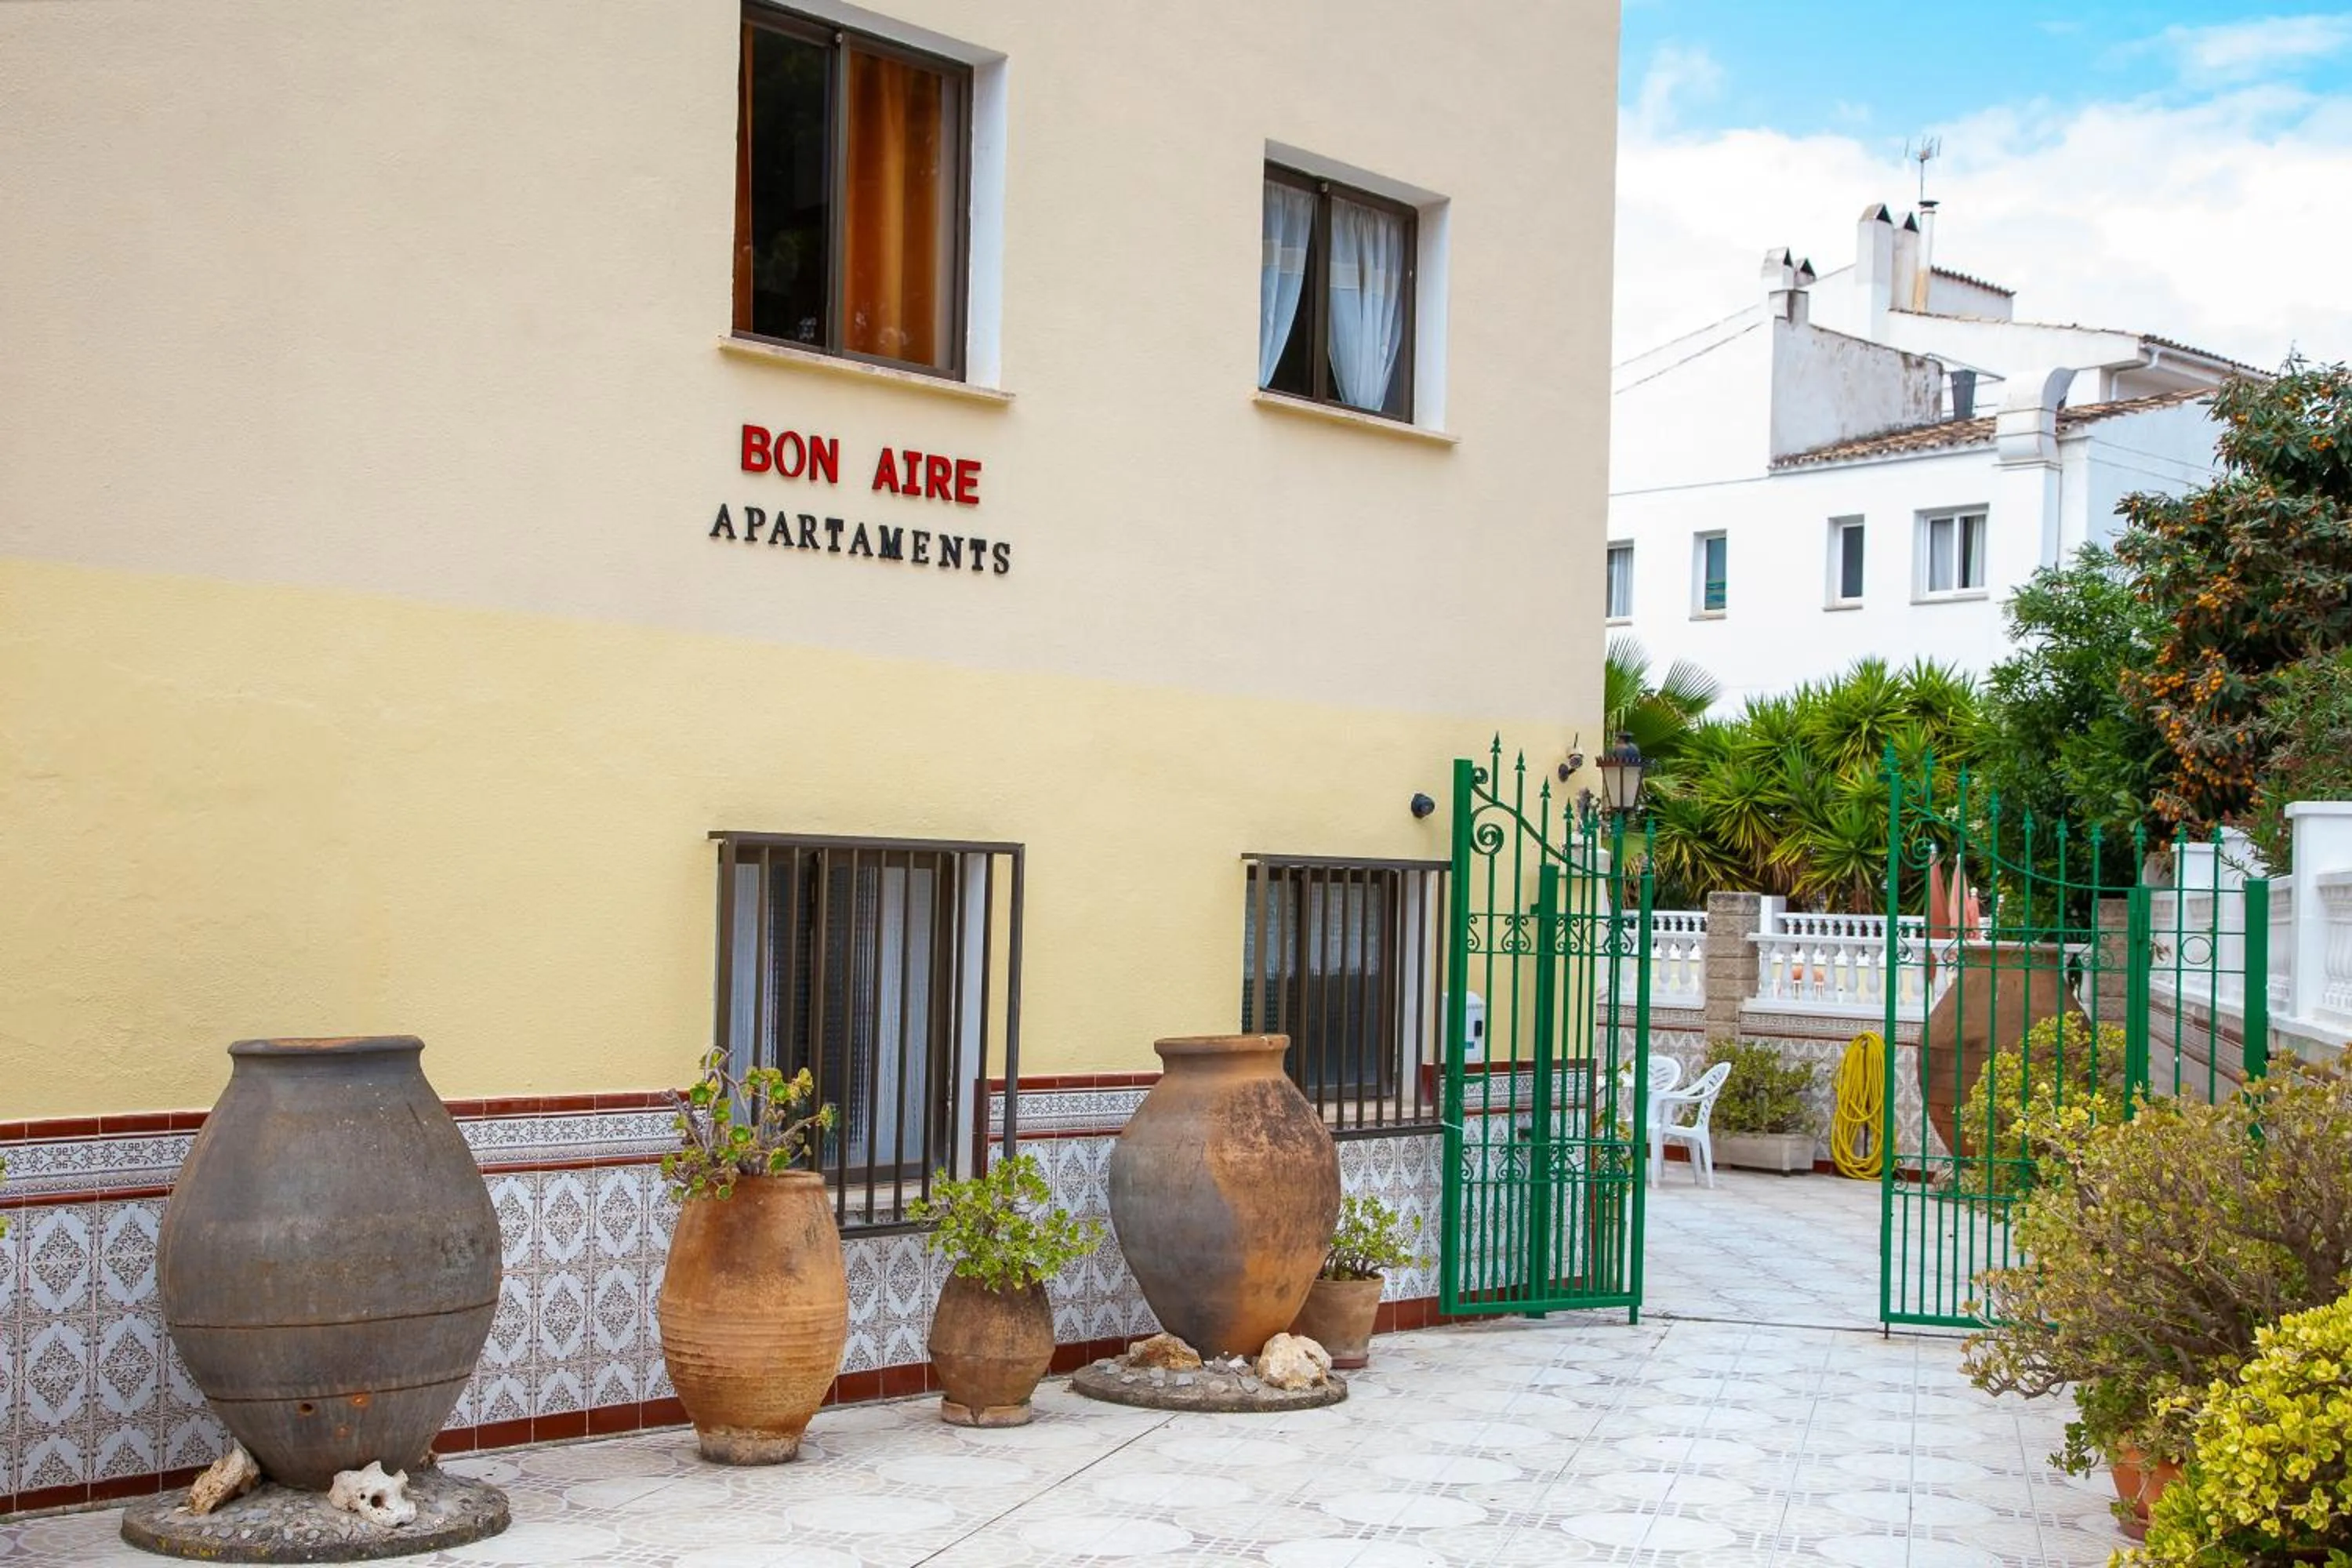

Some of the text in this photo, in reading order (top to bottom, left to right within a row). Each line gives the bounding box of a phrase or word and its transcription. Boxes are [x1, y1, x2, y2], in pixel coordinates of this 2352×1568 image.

[742, 424, 982, 505] BON AIRE
[709, 503, 1011, 575] APARTAMENTS
